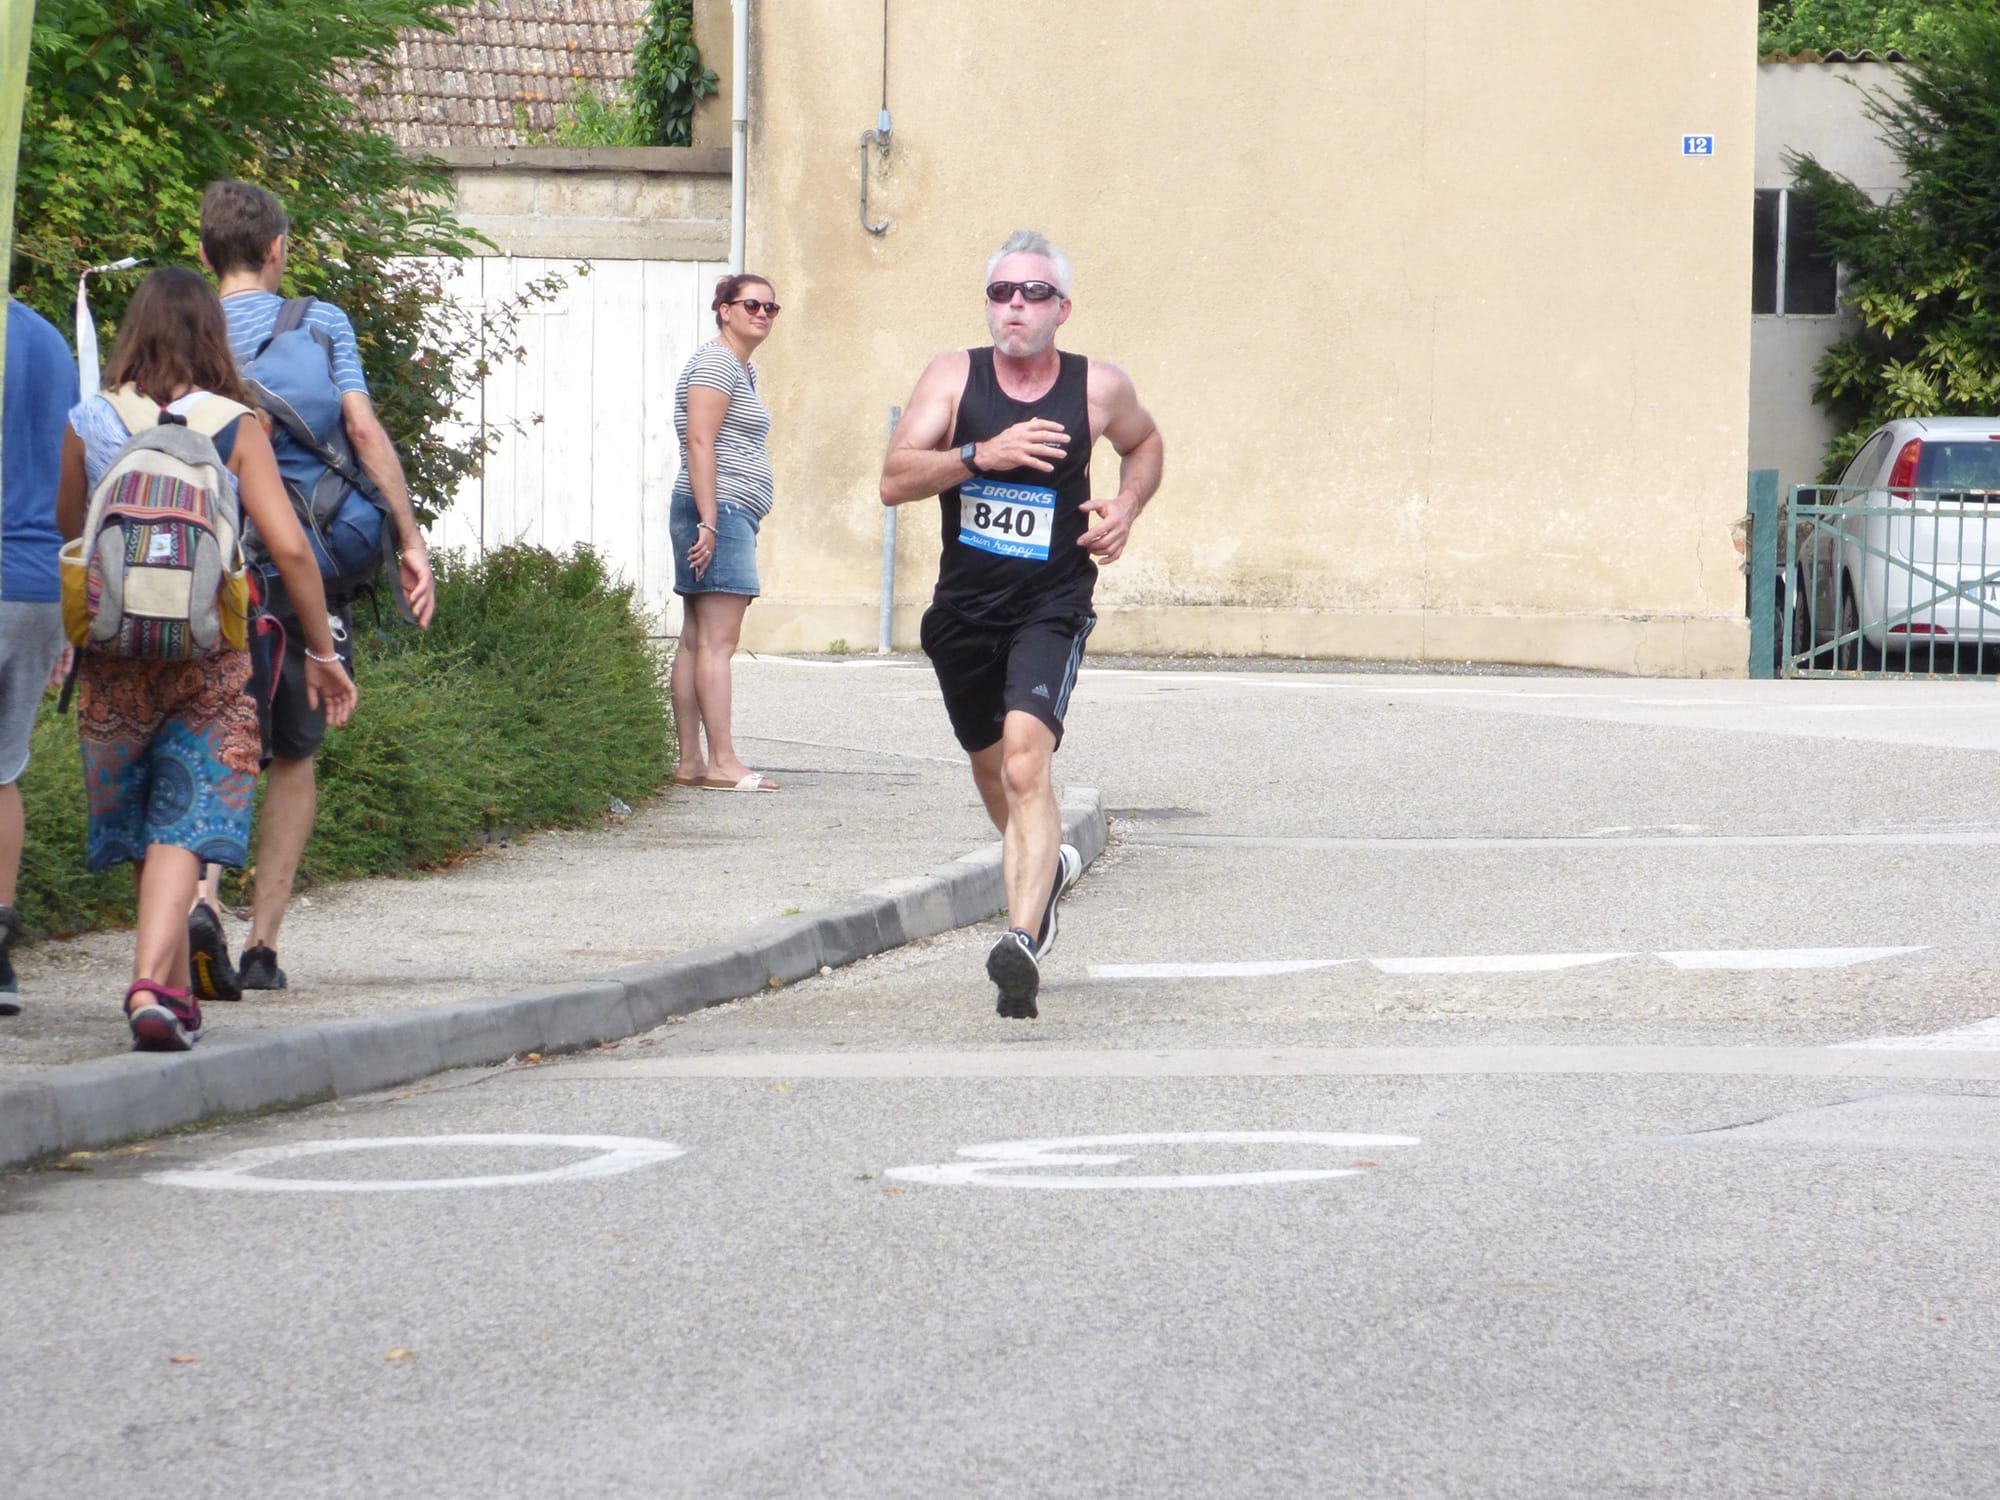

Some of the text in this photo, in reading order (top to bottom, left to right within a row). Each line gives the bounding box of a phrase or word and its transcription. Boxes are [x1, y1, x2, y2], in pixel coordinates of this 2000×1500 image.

[1687, 137, 1707, 153] 12
[982, 485, 1053, 504] BROOKS
[974, 502, 1035, 537] 840
[970, 535, 1034, 558] run happy
